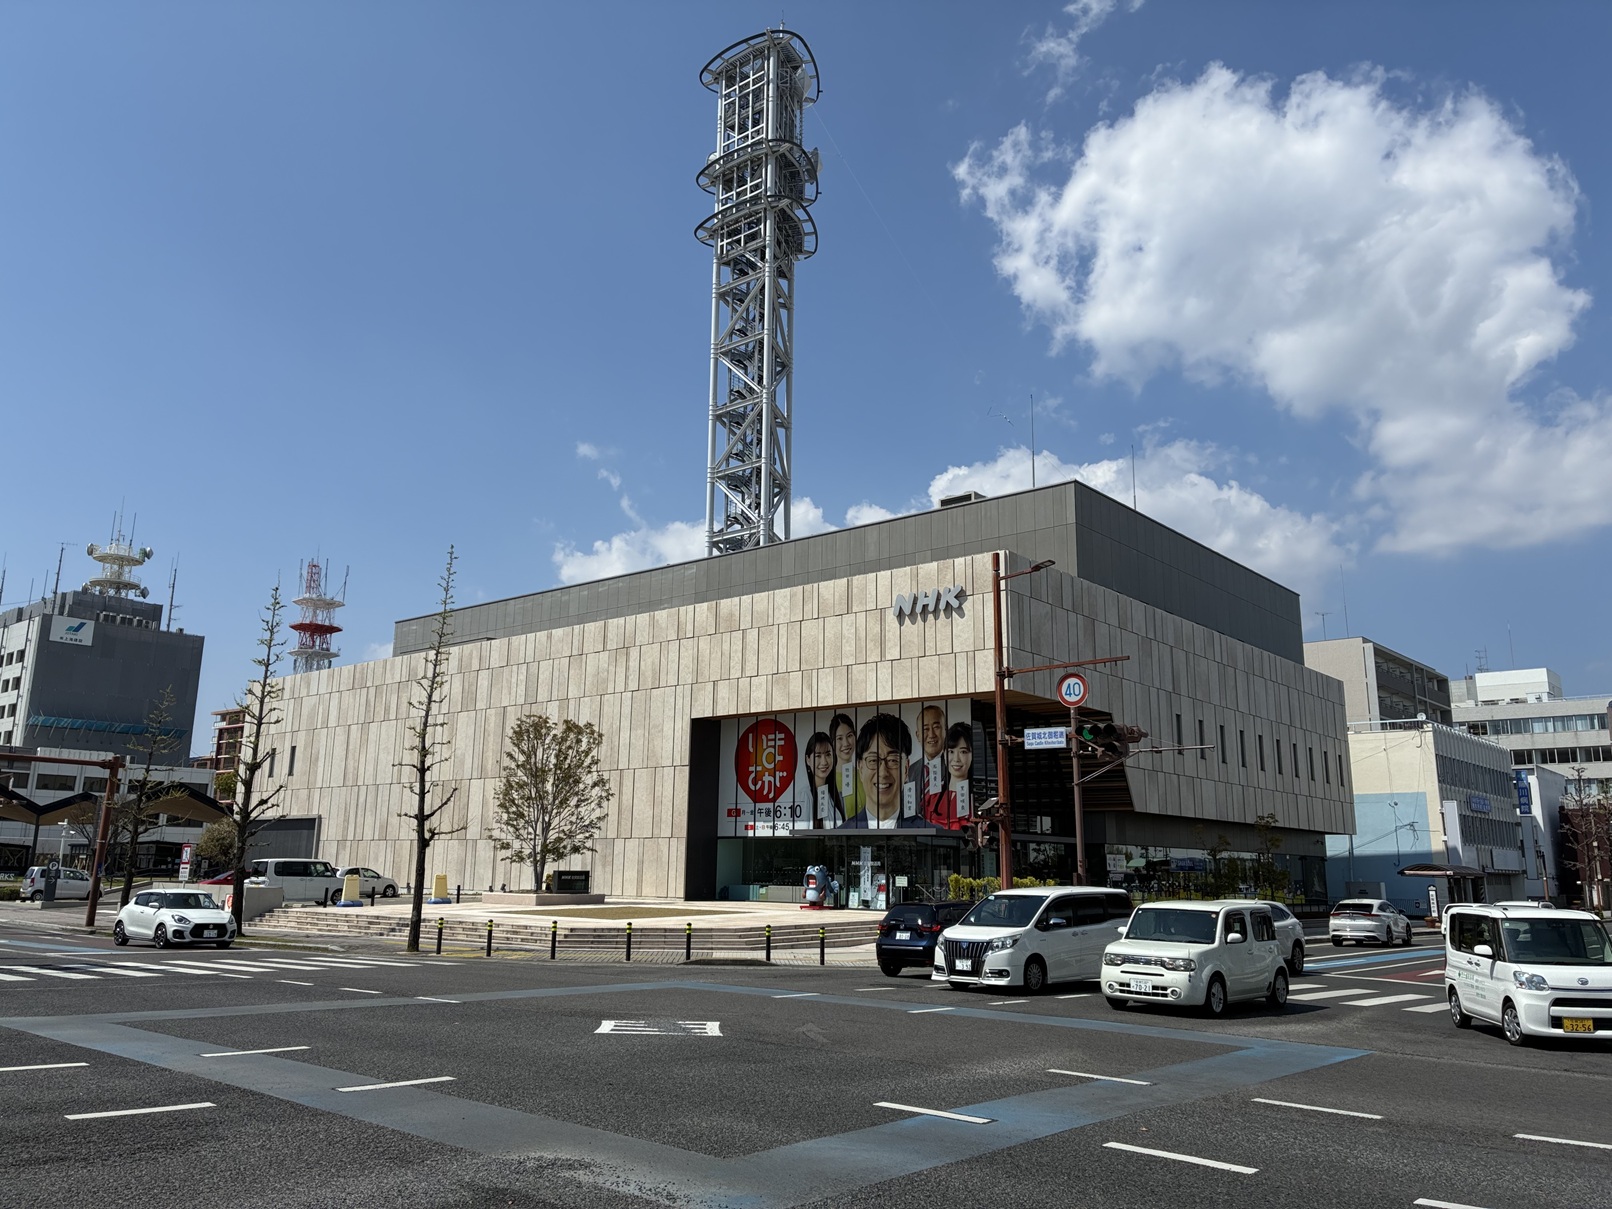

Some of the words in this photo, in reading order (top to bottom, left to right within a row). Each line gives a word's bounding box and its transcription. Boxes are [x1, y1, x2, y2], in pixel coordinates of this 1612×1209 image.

[893, 584, 964, 617] NHK
[1065, 682, 1081, 697] 40
[748, 731, 785, 769] いま
[748, 764, 787, 799] さが
[757, 807, 772, 818] 午後
[775, 804, 802, 819] 6:10
[774, 822, 790, 831] 6:45
[1570, 1023, 1592, 1032] 32-56
